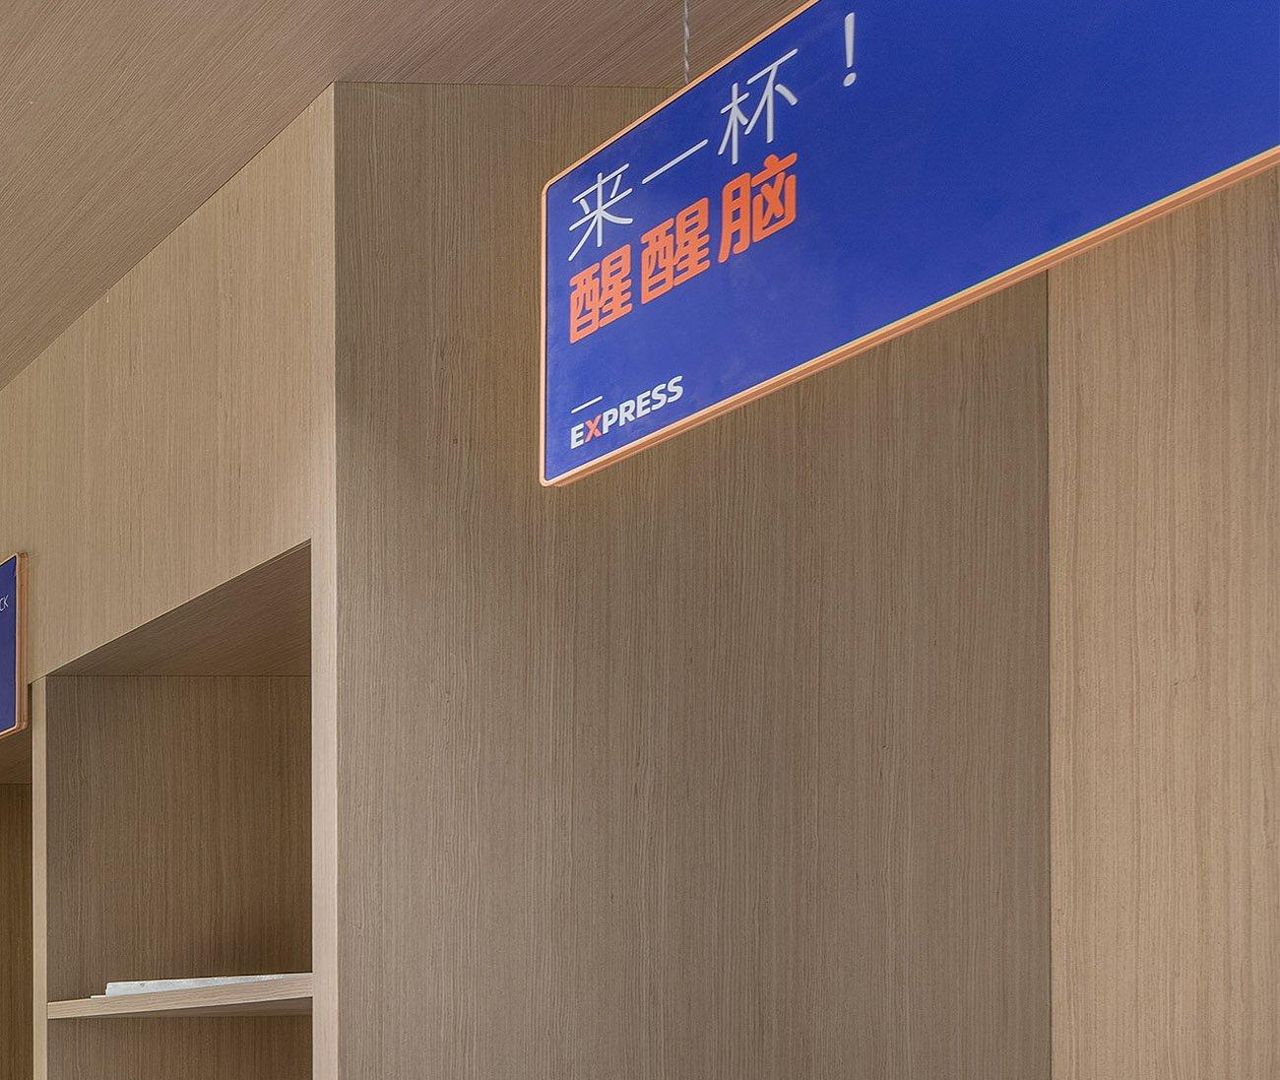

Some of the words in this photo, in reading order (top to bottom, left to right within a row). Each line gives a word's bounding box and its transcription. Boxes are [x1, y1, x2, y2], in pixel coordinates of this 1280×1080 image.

[568, 151, 799, 345] 醒醒脑
[569, 375, 685, 451] EXPRESS
